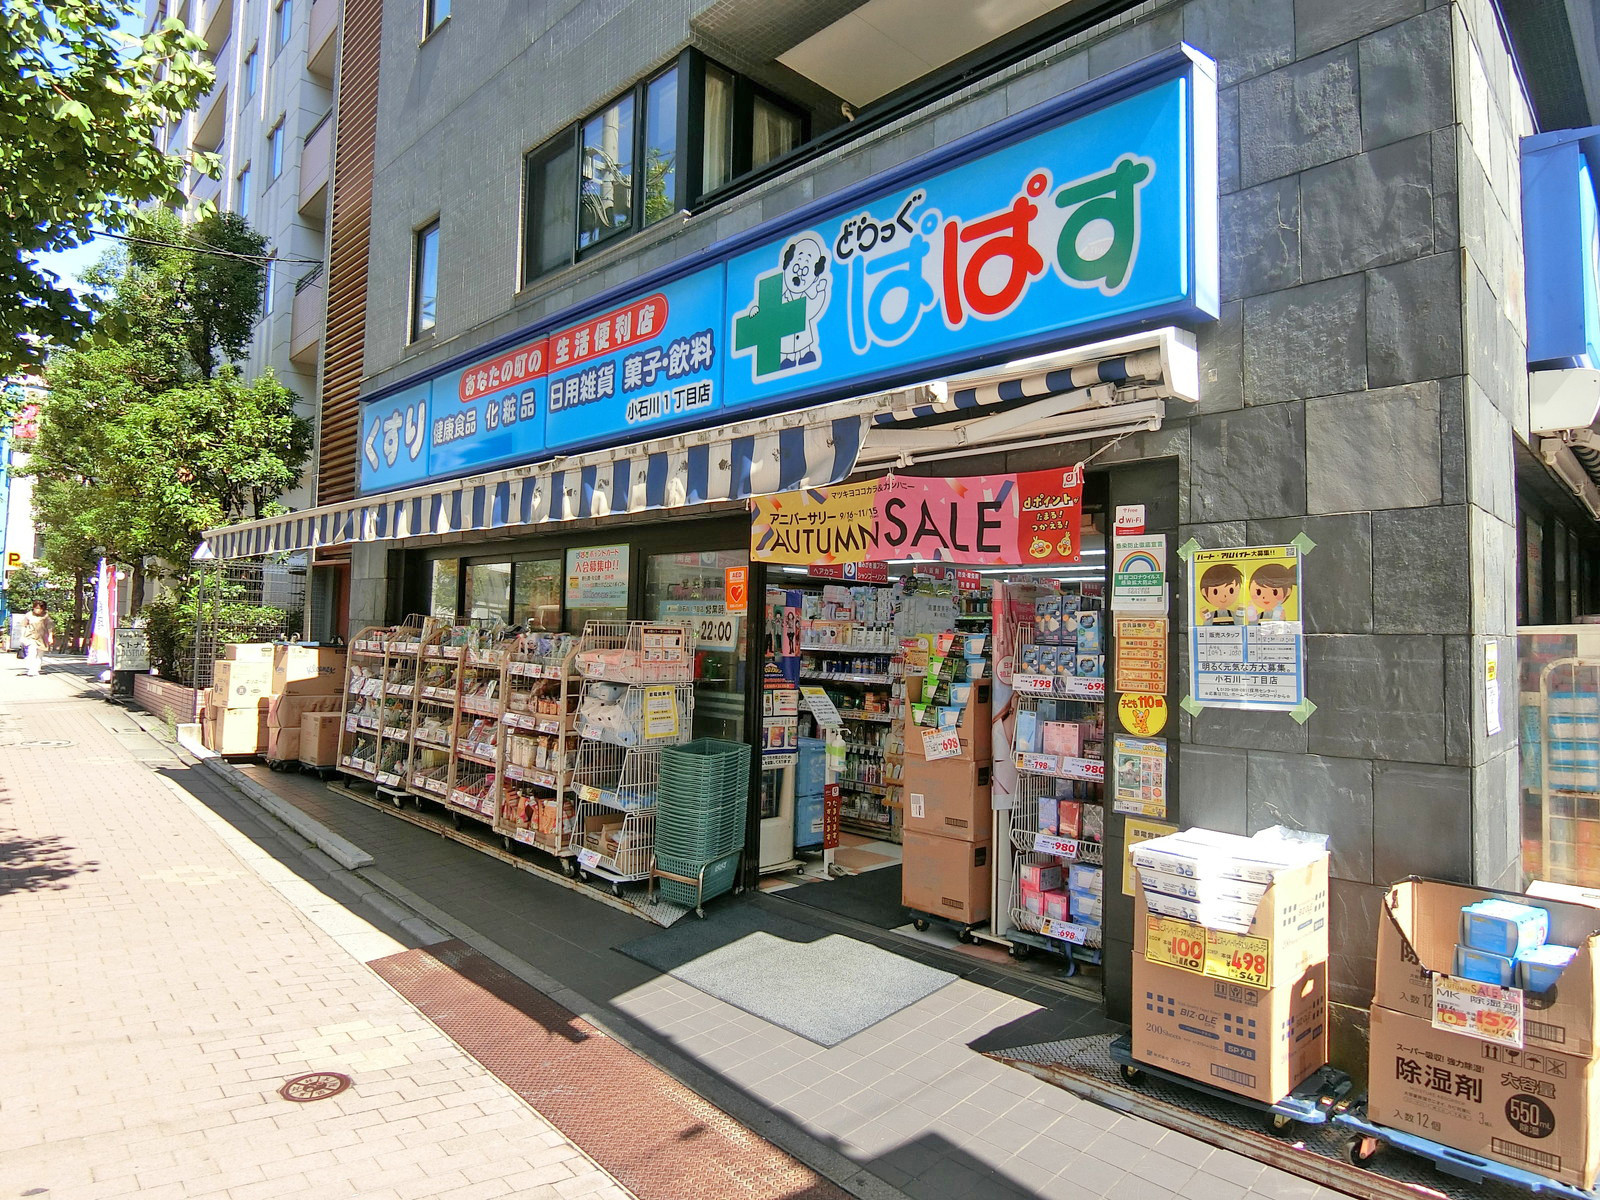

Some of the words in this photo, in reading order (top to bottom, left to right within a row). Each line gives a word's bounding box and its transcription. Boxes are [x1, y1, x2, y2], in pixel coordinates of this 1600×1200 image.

[838, 193, 923, 259] どらっぐ
[850, 158, 1150, 348] ぱぱす
[465, 348, 542, 396] あなたの町の
[556, 304, 656, 364] 生活便利店
[433, 410, 477, 446] 健康食品
[485, 389, 536, 430] 化粧品
[550, 364, 614, 410] 日用雑貨
[623, 333, 713, 390] 菓子・飲料
[627, 383, 711, 421] 小石川1丁目店
[365, 399, 425, 472] くすり
[769, 511, 837, 526] アニバーサリー
[1036, 510, 1063, 521] たまる!
[770, 521, 880, 554] AUTUMN
[884, 497, 1002, 553] SALE
[1032, 520, 1069, 531] つかえる!
[575, 560, 619, 573] 入会募集中!!
[813, 567, 839, 575] ヘアカラー
[705, 604, 725, 614] 営業時
[700, 620, 732, 641] 22:00
[1202, 663, 1291, 672] 明るく元気な方大募集。
[1032, 679, 1051, 688] 798
[1215, 675, 1278, 685] 小石川一丁目店
[1121, 696, 1163, 708] 子ども110番
[942, 737, 959, 751] 698
[1034, 761, 1048, 770] 798
[1084, 764, 1104, 775] 980
[1055, 842, 1075, 853] 980
[1059, 929, 1075, 939] 698
[1172, 937, 1203, 960] 100
[1232, 950, 1266, 974] 498
[1239, 972, 1262, 982] 547
[1471, 984, 1498, 998] SALE
[1437, 988, 1460, 1001] MK
[1470, 996, 1518, 1011] 除湿剤
[1477, 1010, 1518, 1030] 159
[1396, 1043, 1445, 1062] スーパー吸収!
[1447, 1056, 1485, 1074] 強力除湿!
[1395, 1056, 1483, 1104] 除湿剤
[1501, 1072, 1556, 1100] 大容量
[1393, 1108, 1442, 1131] 入数12個
